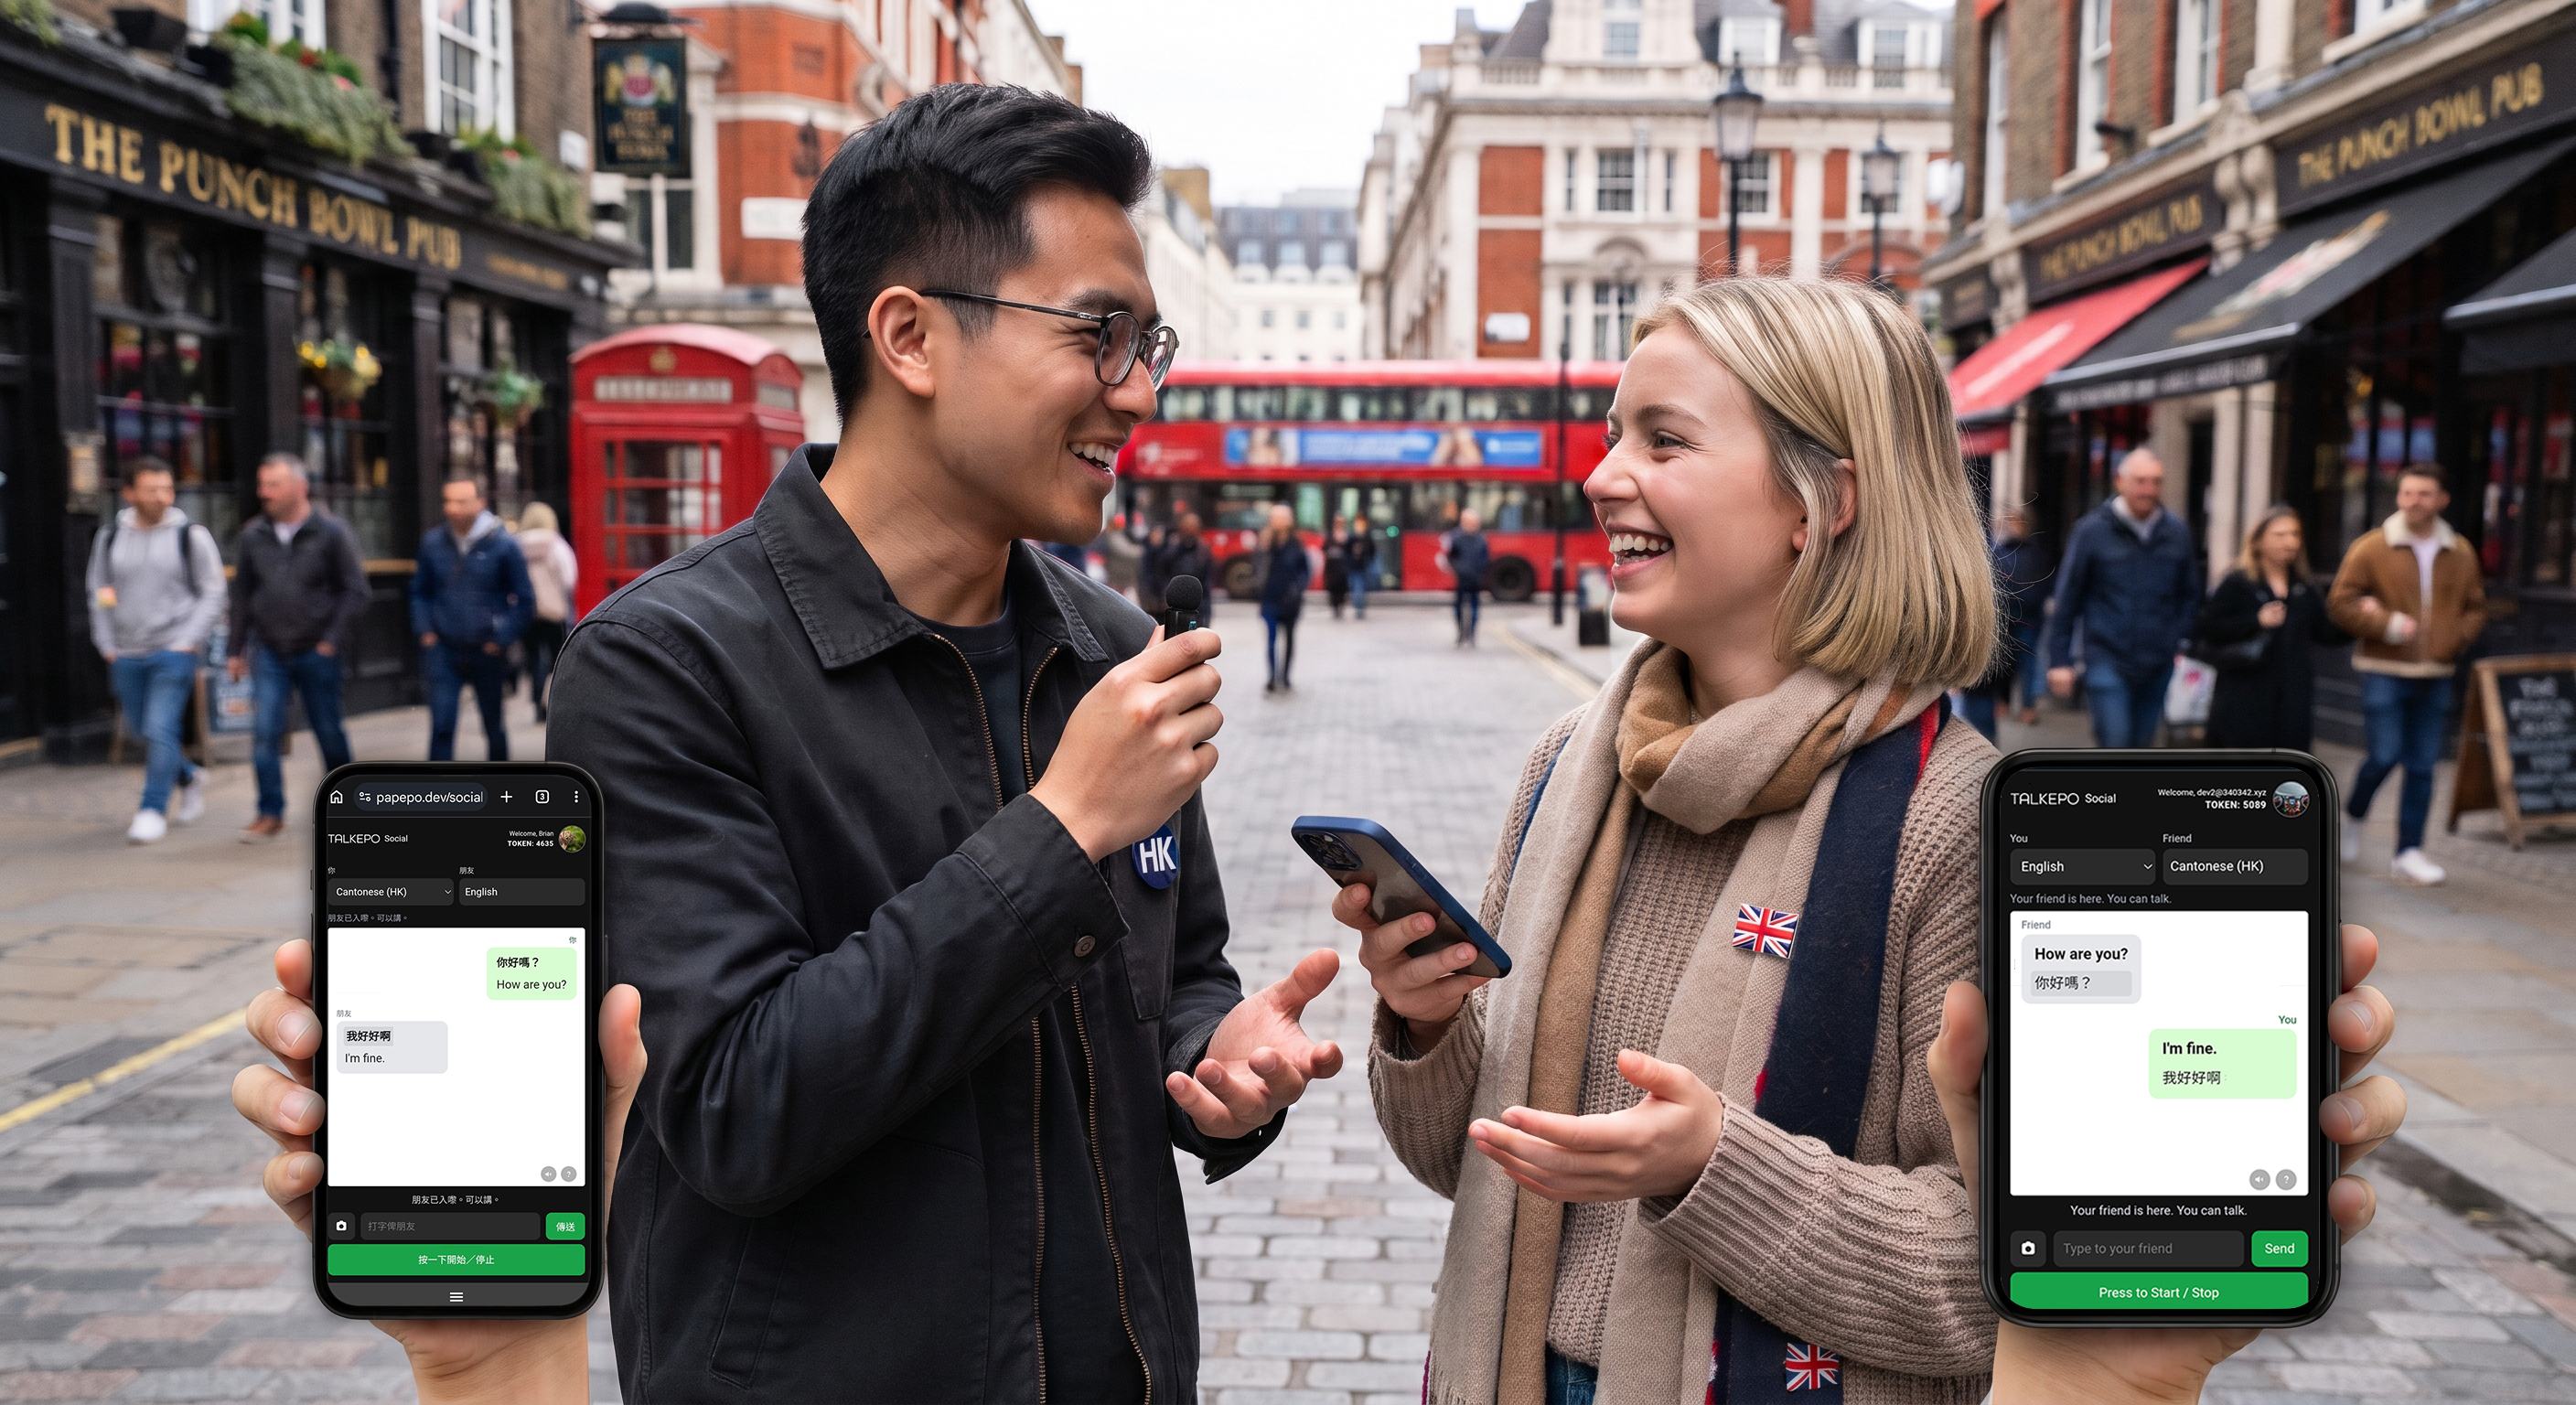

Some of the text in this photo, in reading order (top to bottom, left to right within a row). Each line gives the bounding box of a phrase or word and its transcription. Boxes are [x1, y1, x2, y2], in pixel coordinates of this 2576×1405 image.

[2490, 62, 2544, 120] PUB
[45, 103, 461, 269] THE PUNCH BOWL PUB
[375, 790, 484, 806] papepo.dev/social
[539, 792, 546, 802] 3
[2010, 792, 2117, 806] TALKEPO Social
[2157, 788, 2267, 799] Welcome, dev2@340342.xyz
[2205, 799, 2267, 810] TOKEN: 5089
[327, 833, 408, 844] TALKEPO Social
[509, 830, 538, 838] Welcome,
[2009, 833, 2029, 843] You
[2162, 832, 2193, 843] Friend
[1139, 836, 1176, 874] HK
[327, 866, 337, 875] 你
[458, 866, 475, 875] 朋友
[2021, 860, 2065, 875] English
[2170, 859, 2264, 874] Cantonese (HK)
[336, 886, 407, 898] Cantonese (HK)
[465, 886, 498, 899] English
[2010, 893, 2173, 905] Your friend is here. You can talk.
[2021, 919, 2052, 930] Friend
[568, 936, 577, 945] 你
[2034, 947, 2129, 963] How are you?
[496, 956, 540, 969] 你好嗎？
[496, 979, 567, 992] How are you?
[2034, 975, 2090, 991] 你好嗎？
[336, 1009, 352, 1018] 朋友
[2278, 1014, 2297, 1025] You
[346, 1030, 392, 1042] 我好好啊
[2163, 1041, 2217, 1055] I'm fine.
[344, 1052, 385, 1064] I'm fine.
[2163, 1070, 2221, 1086] 我好好啊
[2070, 1204, 2248, 1217] Your friend is here. You can talk.
[555, 1221, 575, 1232] 傳送
[2063, 1242, 2173, 1257] Type to your friend
[2264, 1242, 2295, 1255] Send
[2098, 1286, 2133, 1299] Press
[2135, 1287, 2149, 1299] to
[2151, 1286, 2181, 1299] Start
[2191, 1286, 2220, 1302] Stop
